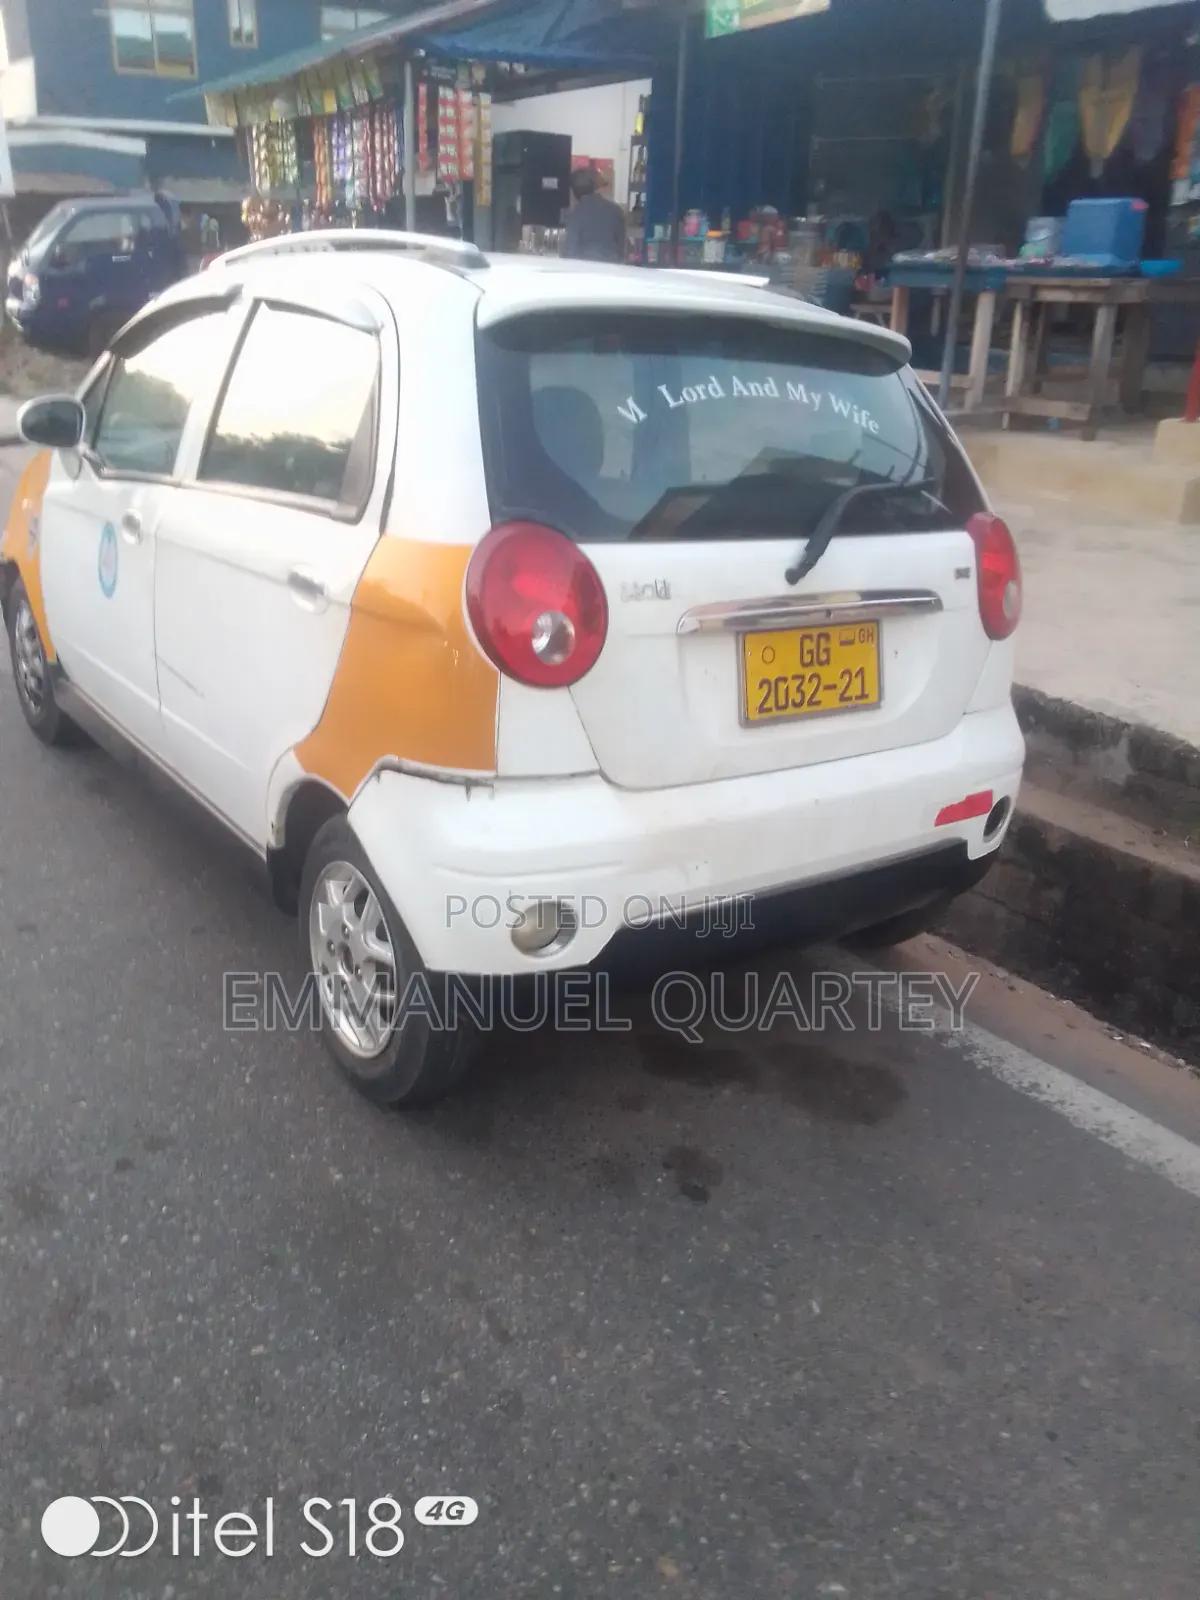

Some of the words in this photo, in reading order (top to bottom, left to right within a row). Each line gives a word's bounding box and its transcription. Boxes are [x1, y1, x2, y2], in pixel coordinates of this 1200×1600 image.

[657, 375, 725, 409] Lord
[732, 375, 780, 398] And
[786, 381, 821, 412] My
[828, 392, 880, 434] Wife
[799, 632, 831, 668] GG
[757, 667, 870, 714] 2032-21
